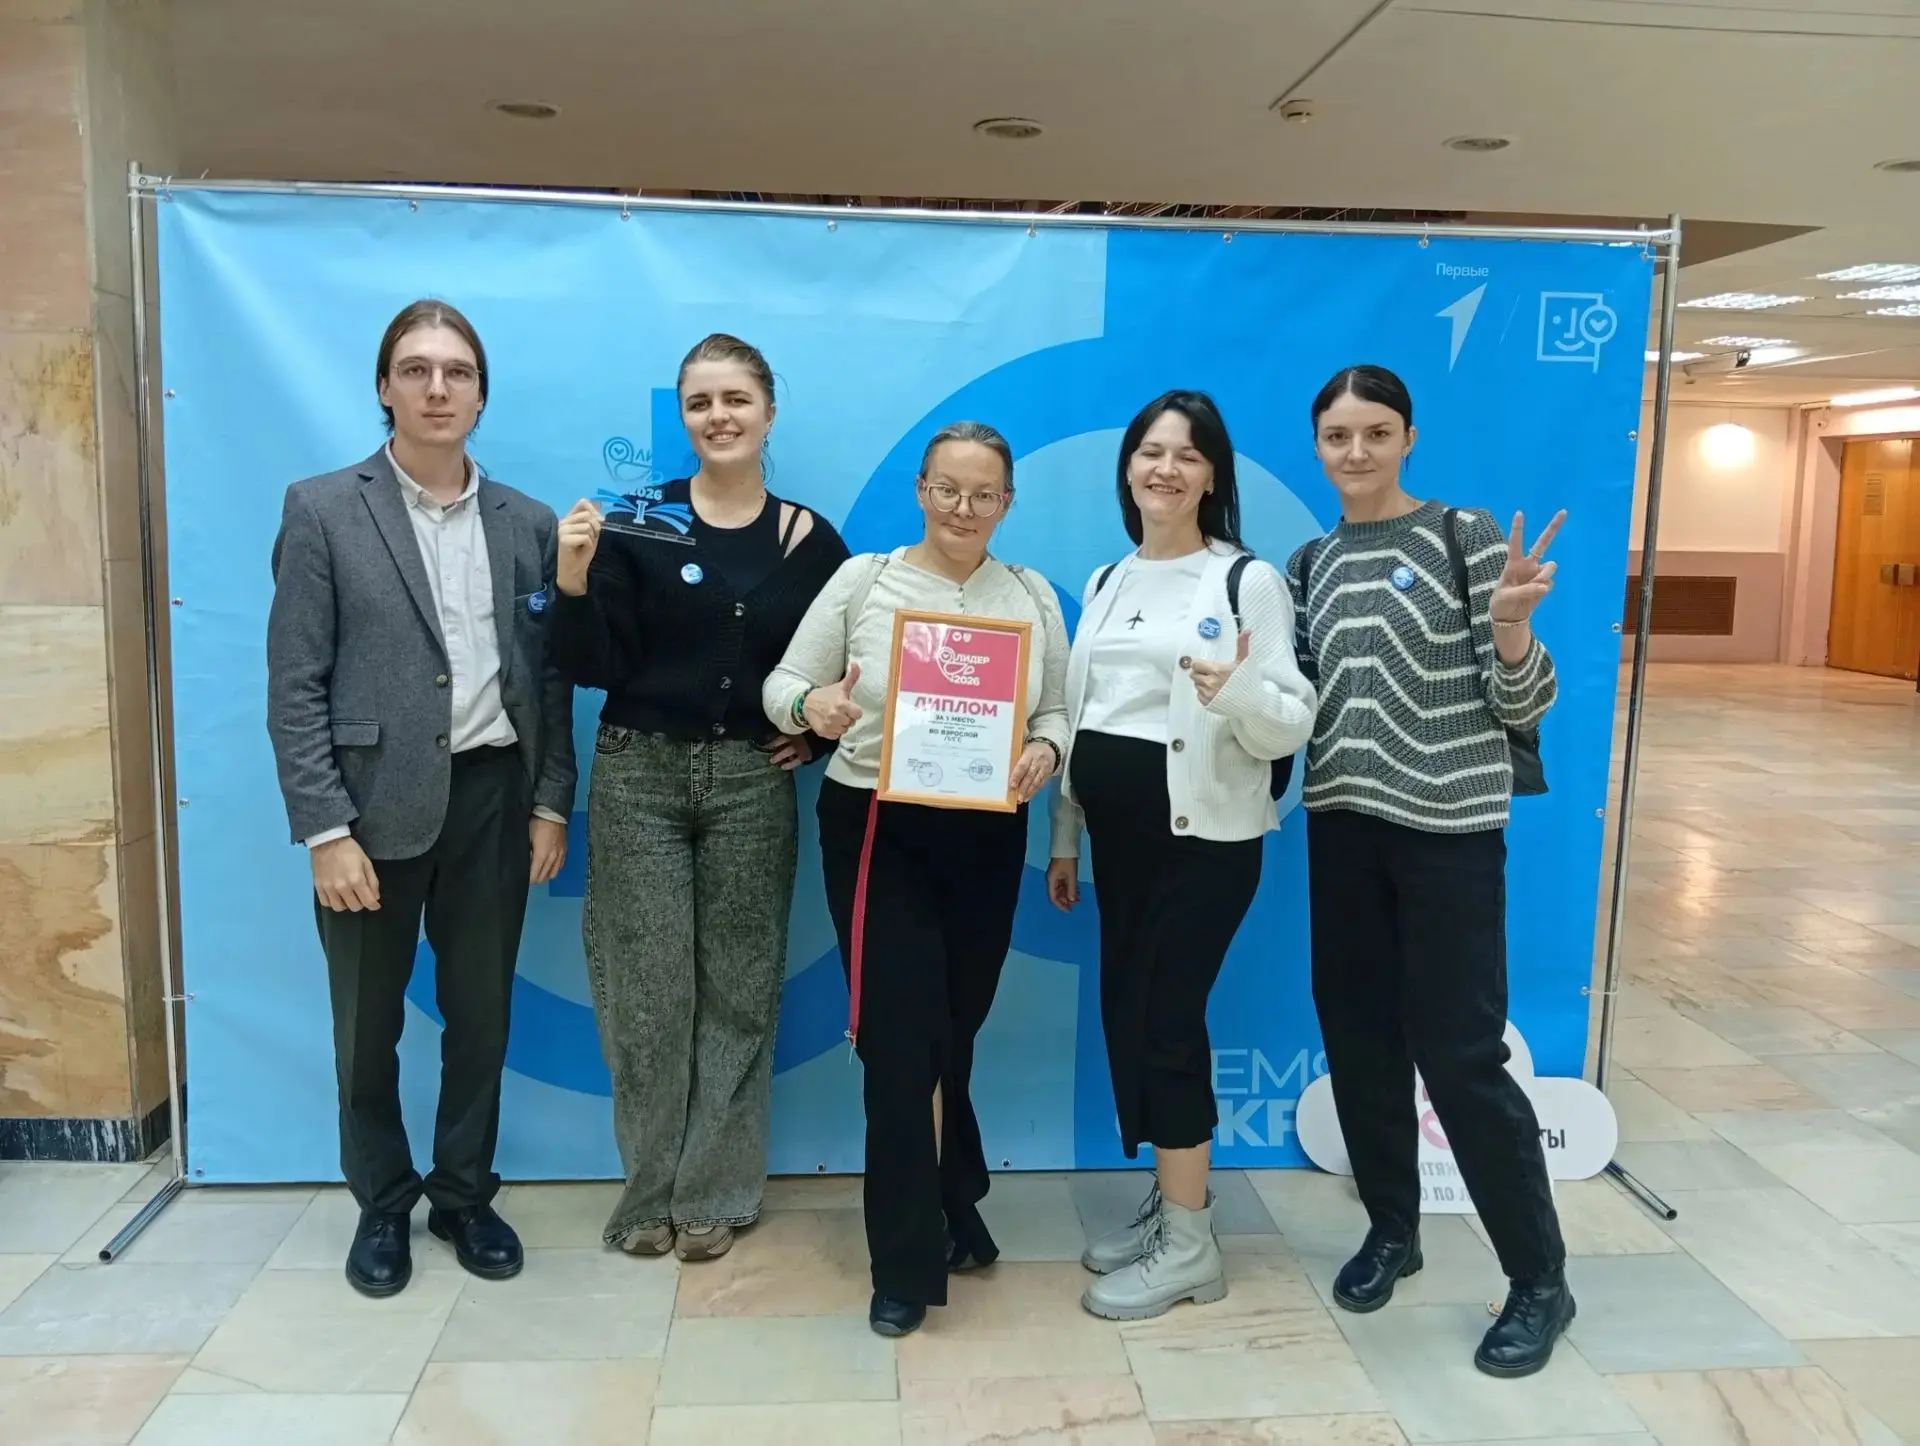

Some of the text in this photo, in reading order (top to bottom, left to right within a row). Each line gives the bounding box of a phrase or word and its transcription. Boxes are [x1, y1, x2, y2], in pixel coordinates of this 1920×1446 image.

[1435, 262, 1489, 279] Первые
[955, 654, 990, 665] ЛИДЕР
[954, 675, 980, 686] 2026
[914, 696, 998, 718] ДИПЛОМ
[940, 729, 978, 738] ВЗРОСЛОЙ
